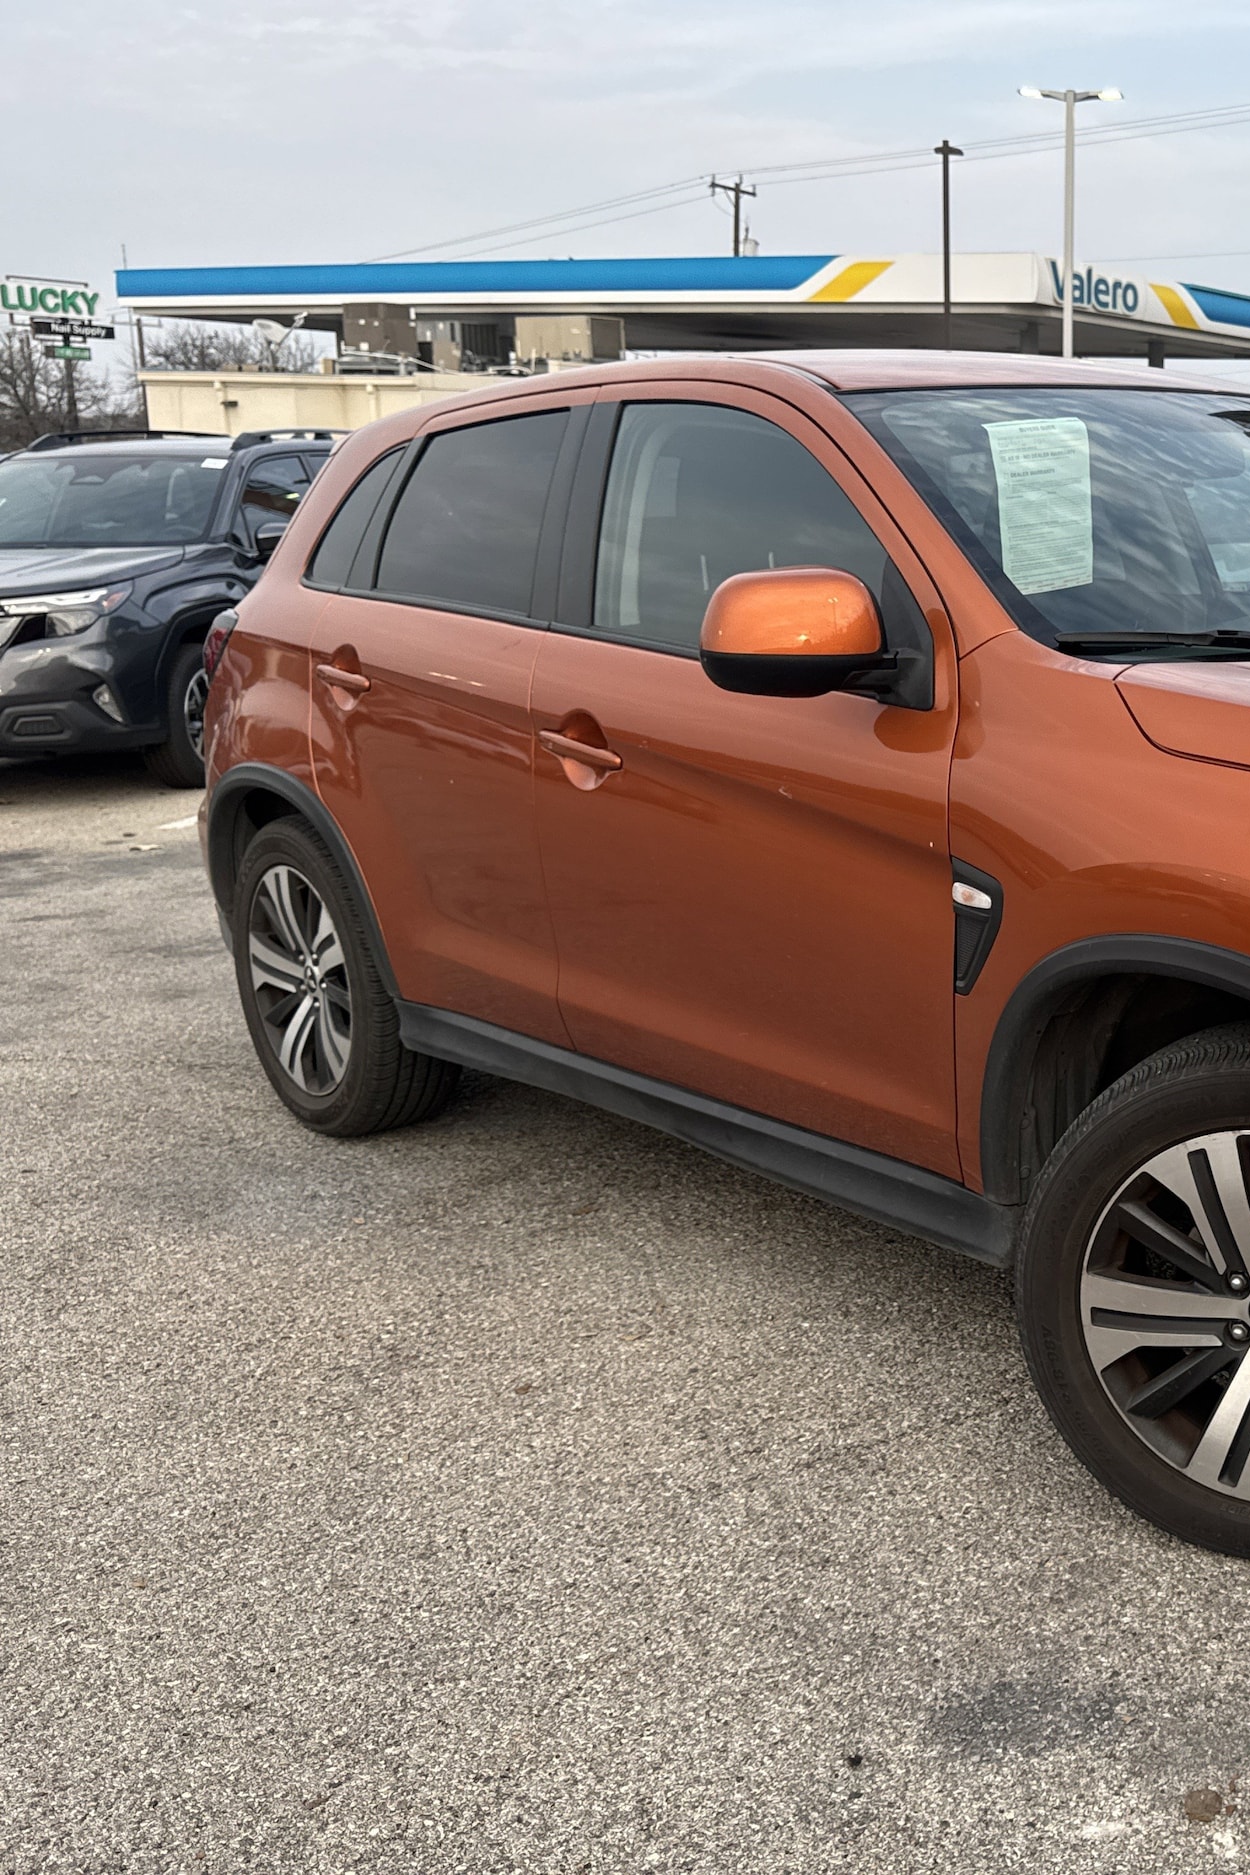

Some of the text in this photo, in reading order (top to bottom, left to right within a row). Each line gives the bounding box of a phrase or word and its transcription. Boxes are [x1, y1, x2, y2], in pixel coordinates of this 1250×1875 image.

[0, 284, 99, 316] LUCKY
[1050, 260, 1139, 313] Valero
[51, 323, 107, 338] Nail Supply
